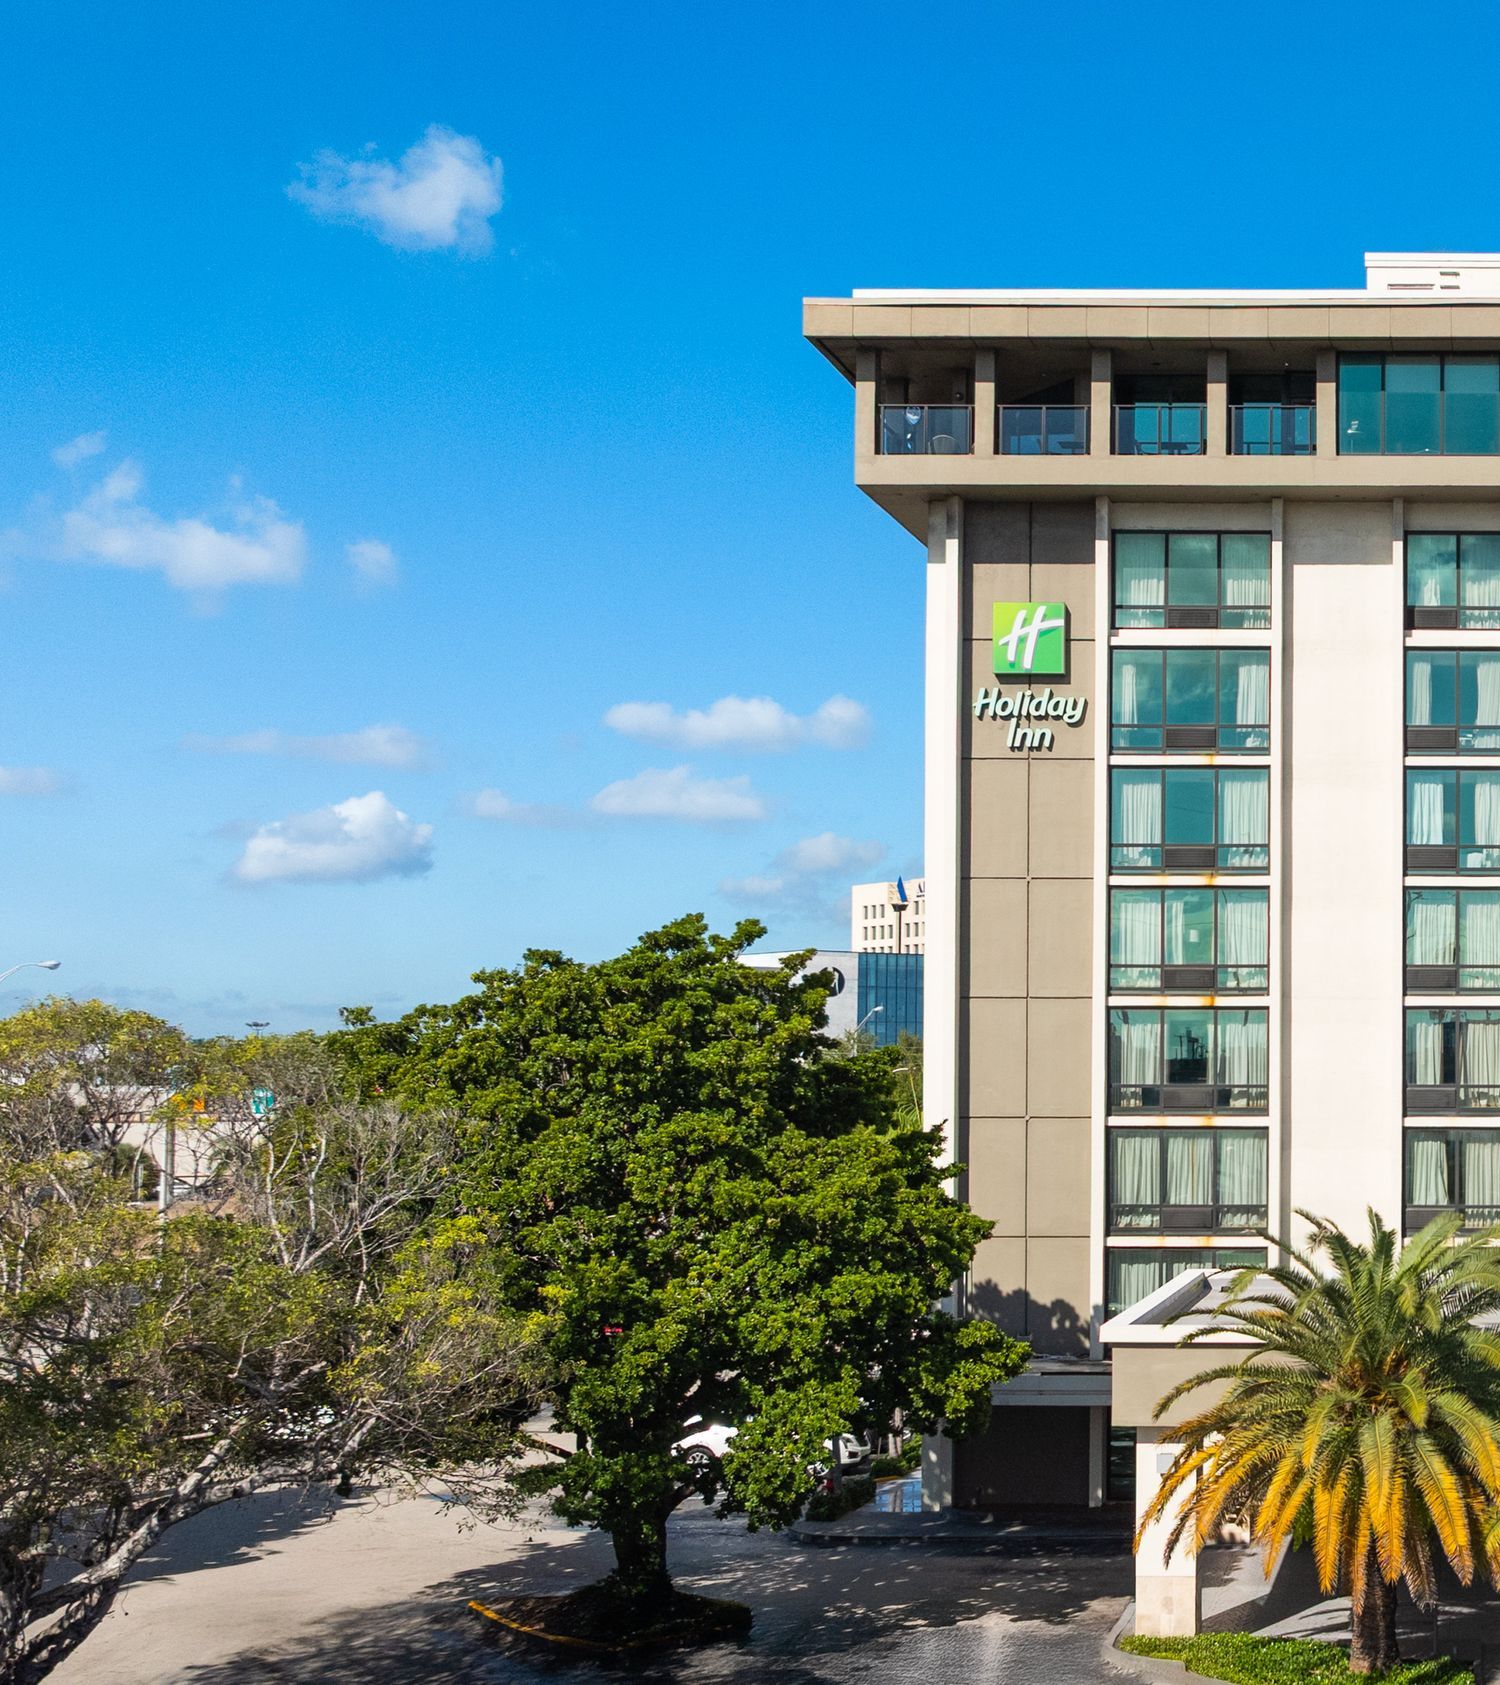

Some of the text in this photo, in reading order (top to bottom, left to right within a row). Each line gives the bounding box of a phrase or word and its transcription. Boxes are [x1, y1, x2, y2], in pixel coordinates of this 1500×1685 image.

[999, 605, 1064, 670] H
[973, 687, 1087, 724] Holiday
[1006, 717, 1052, 748] Inn
